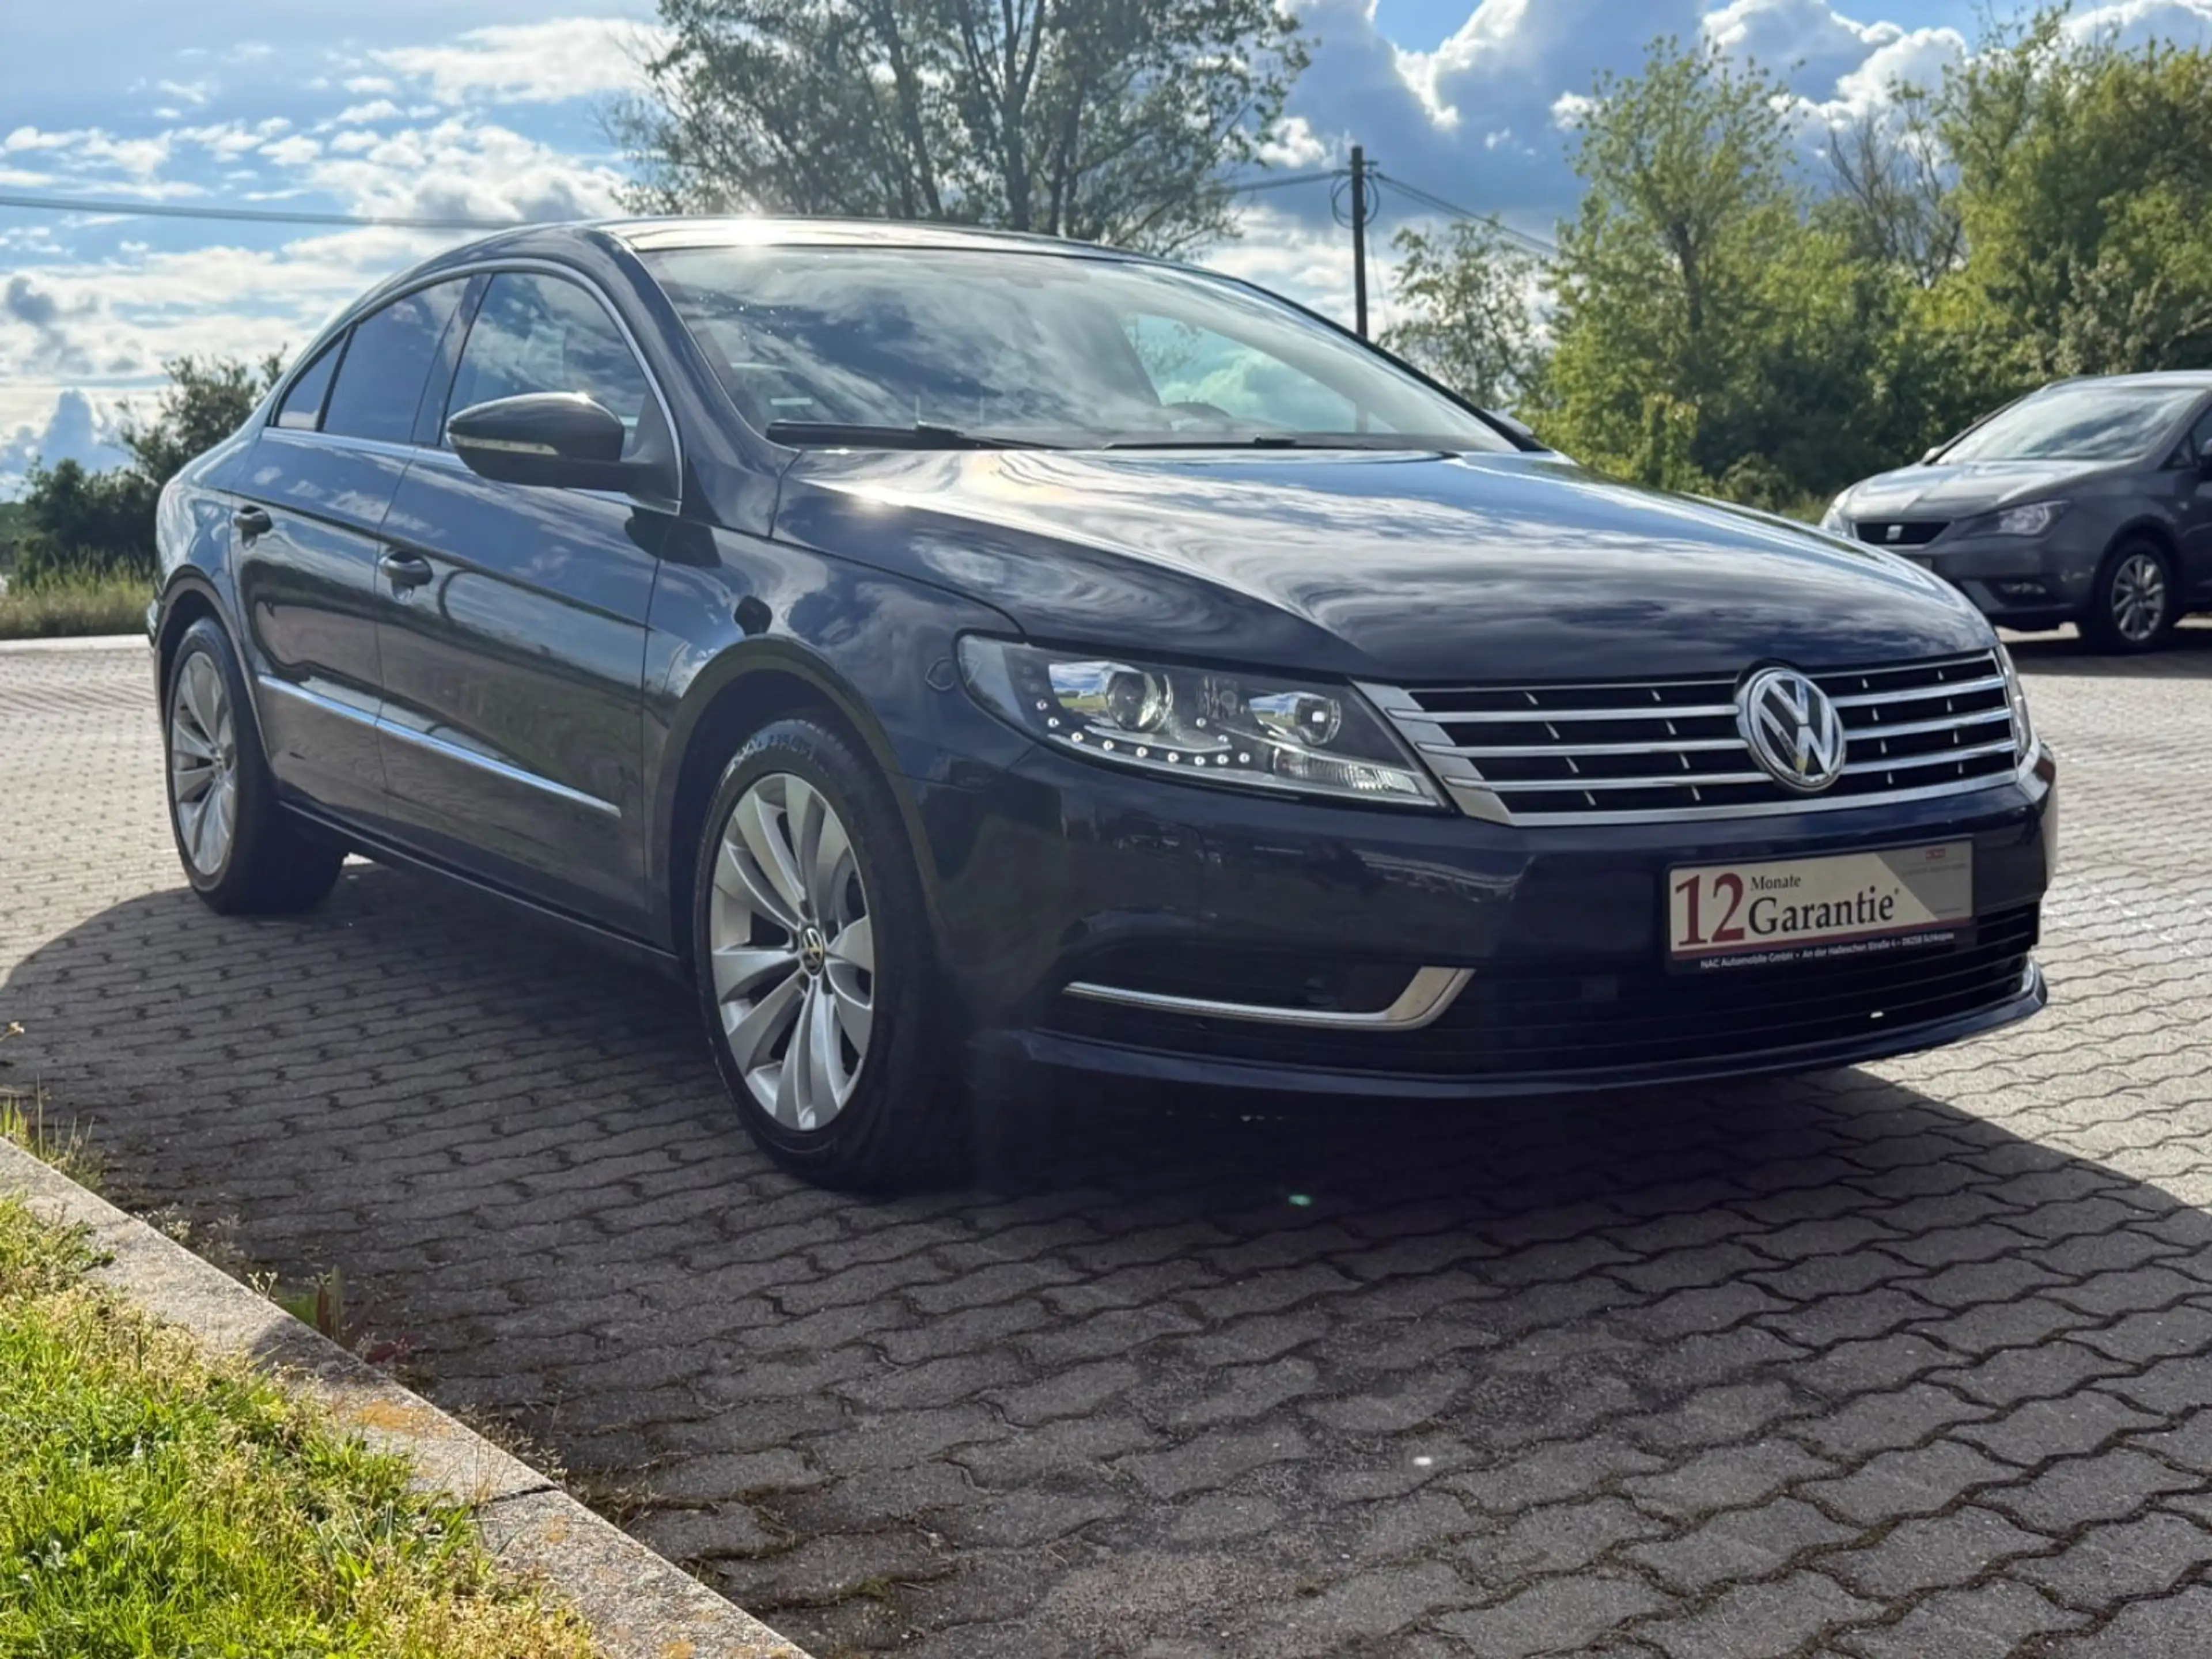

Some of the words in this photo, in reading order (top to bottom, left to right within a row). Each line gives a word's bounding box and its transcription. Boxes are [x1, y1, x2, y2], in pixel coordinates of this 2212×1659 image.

[1749, 874, 1802, 891] Monate
[1675, 872, 1745, 946] 12
[1721, 953, 1767, 968] Automobile
